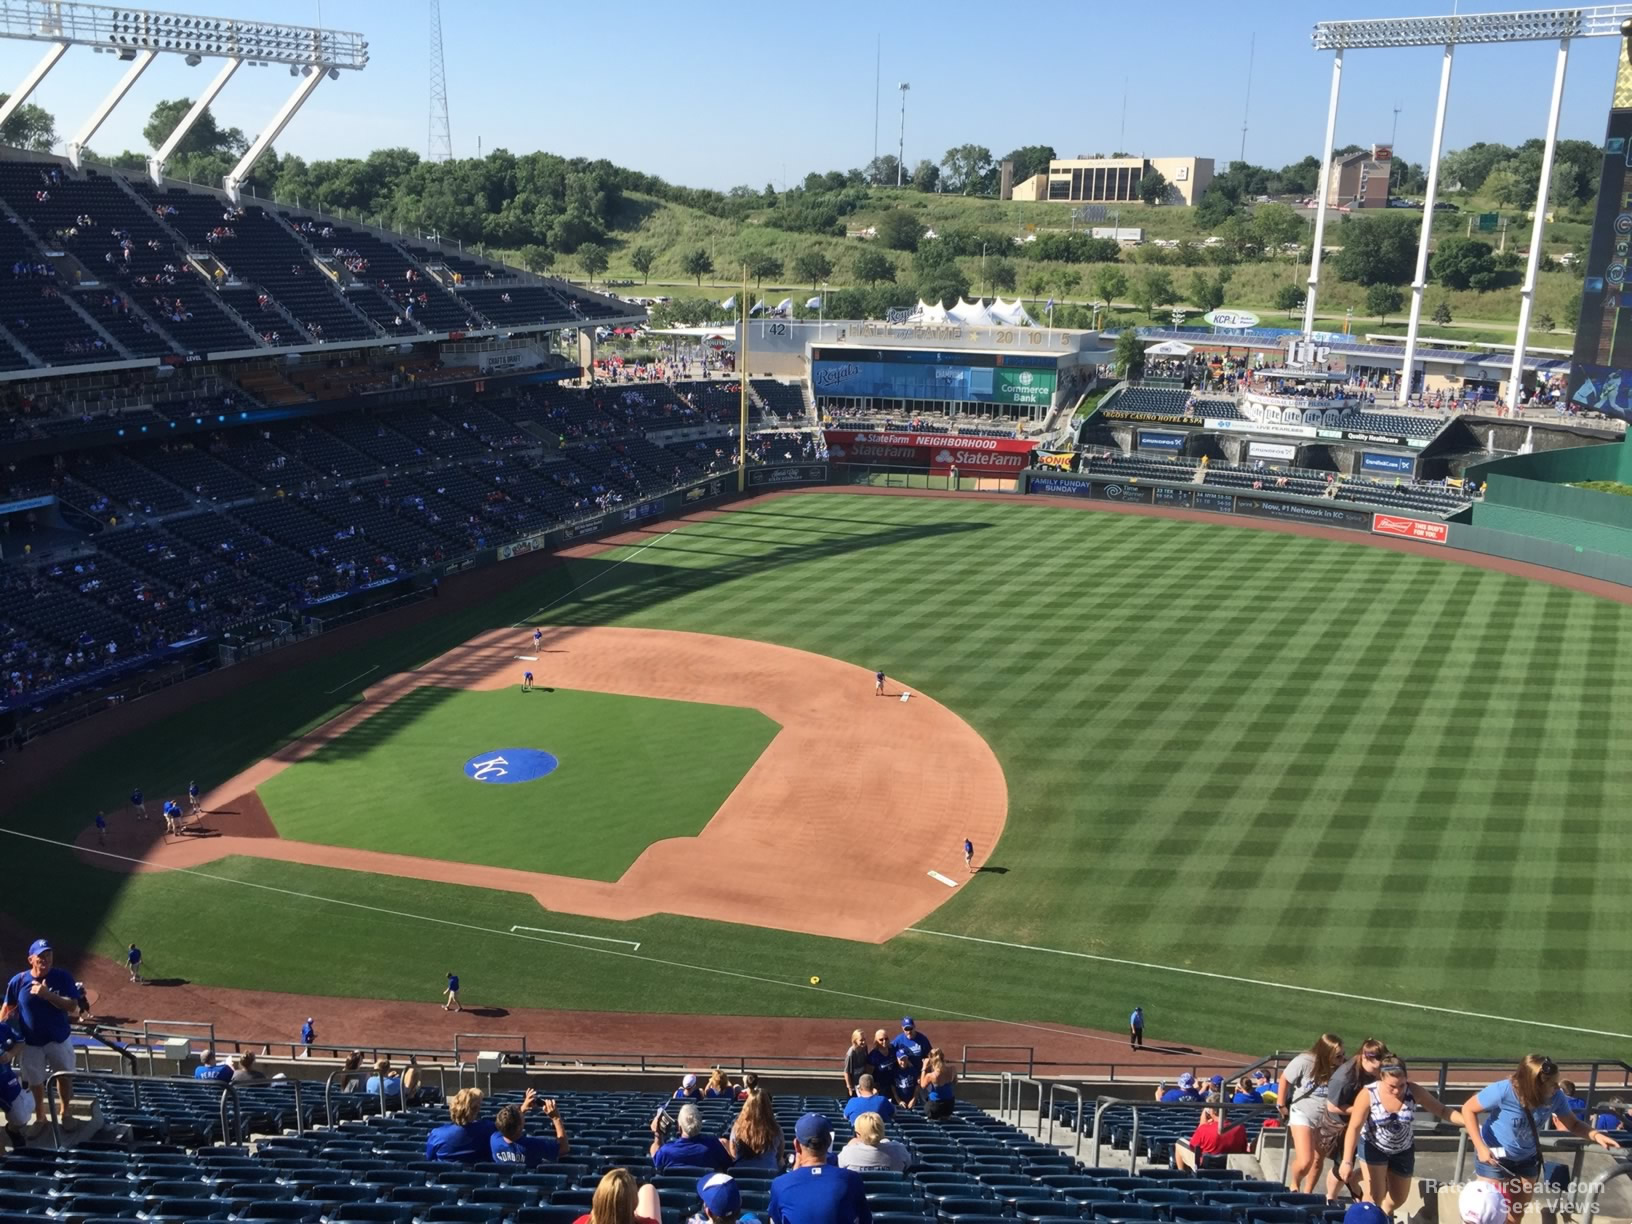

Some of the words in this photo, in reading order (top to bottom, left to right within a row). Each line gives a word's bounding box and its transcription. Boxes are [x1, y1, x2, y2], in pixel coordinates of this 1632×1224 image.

[886, 304, 924, 325] Royals
[769, 323, 786, 336] 42
[849, 323, 892, 337] HALL
[914, 325, 962, 340] FAME
[996, 331, 1014, 345] 20
[1027, 331, 1042, 345] 10
[1060, 333, 1070, 345] 5
[1285, 341, 1331, 368] Lite
[816, 363, 860, 387] Royals
[1001, 383, 1049, 395] Commerce
[1013, 392, 1036, 403] Bank
[1103, 411, 1128, 420] ARGOSY
[1130, 413, 1157, 421] CASINO
[1158, 415, 1181, 423] HOTEL
[1284, 410, 1300, 422] Lite
[1304, 412, 1321, 423] Lite
[915, 435, 998, 449] NEIGHBORHOOD
[1347, 432, 1368, 441] Quality
[1368, 434, 1399, 443] Healthcare
[1040, 455, 1071, 465] SONIC
[1045, 484, 1077, 493] SUNDAY
[1060, 480, 1090, 488] FUNDAY
[1262, 502, 1280, 511] Now,
[1290, 506, 1323, 516] Network
[1332, 511, 1344, 519] KC
[1413, 528, 1425, 536] FOR
[1414, 522, 1427, 531] THIS
[1427, 524, 1444, 533] BUD'S
[200, 1071, 220, 1079] PEREZ
[496, 1151, 526, 1163] GORDON
